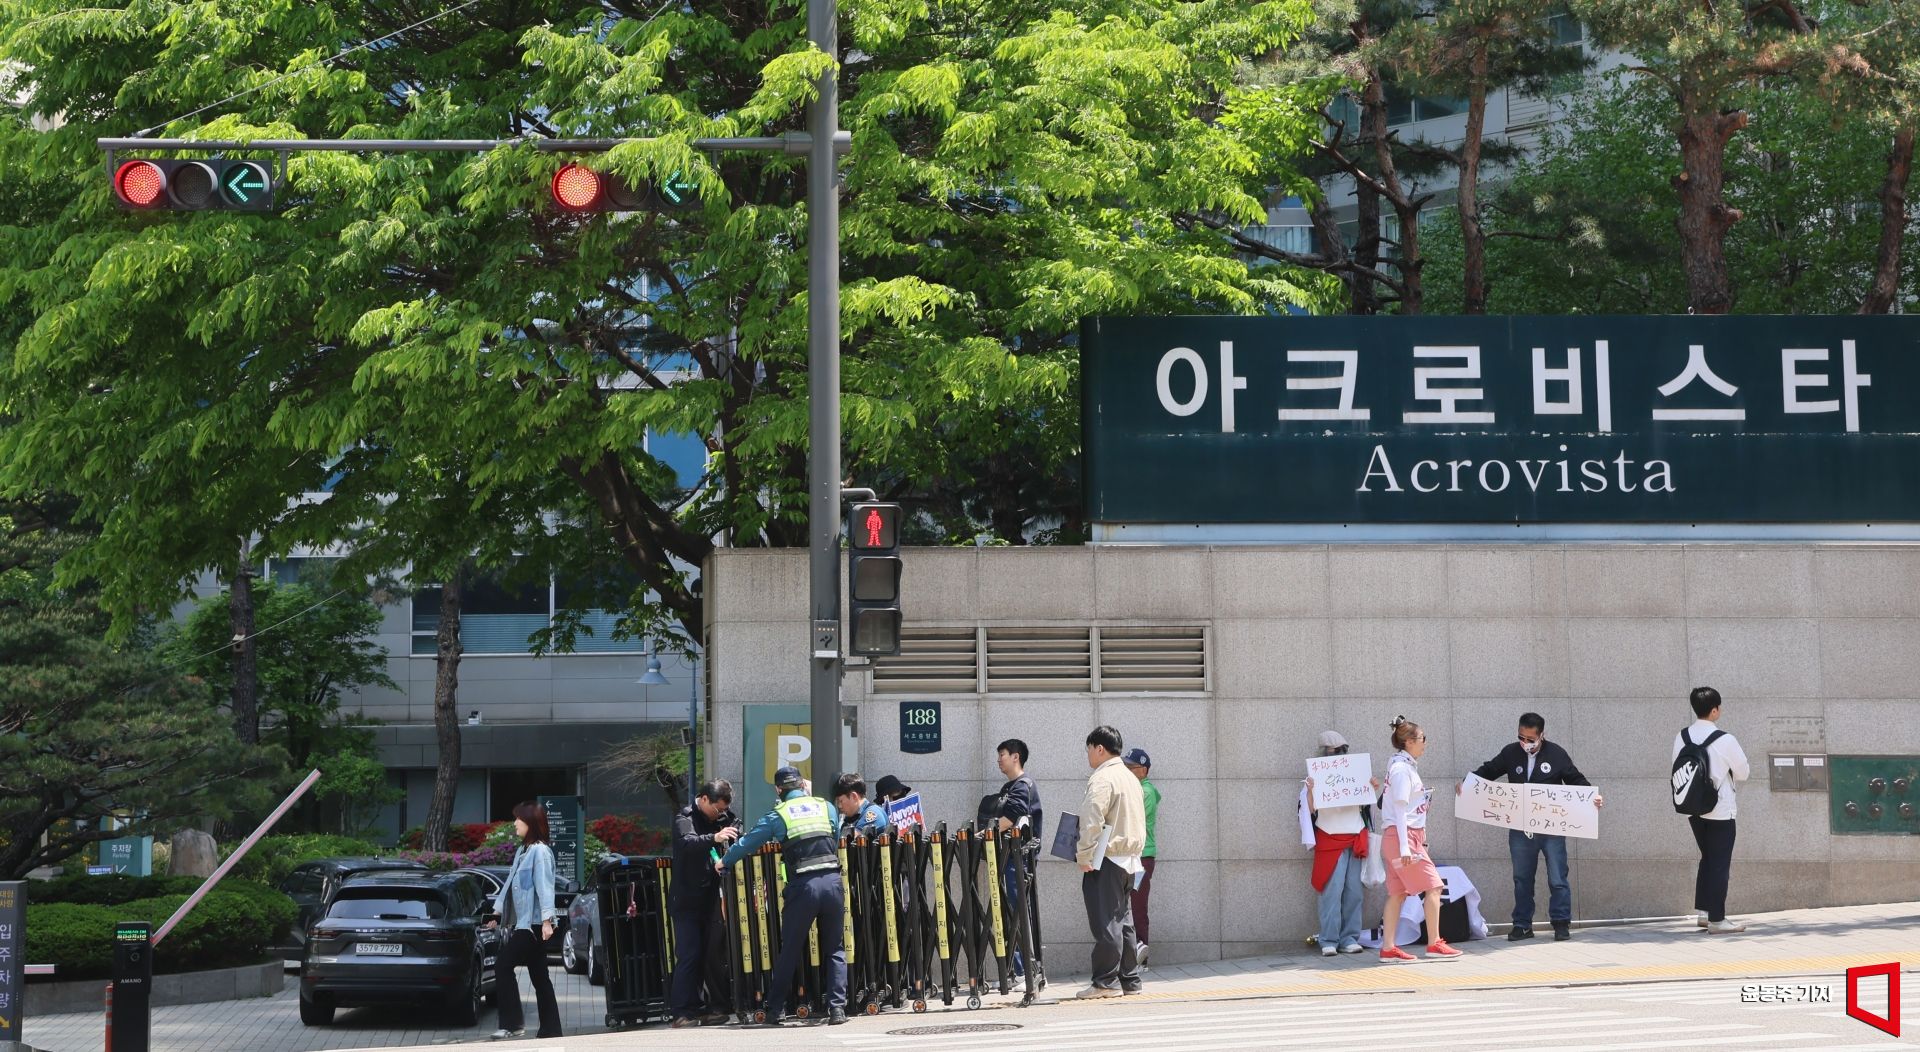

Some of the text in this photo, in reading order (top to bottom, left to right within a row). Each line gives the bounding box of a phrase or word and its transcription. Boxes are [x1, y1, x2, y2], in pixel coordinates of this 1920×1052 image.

[1156, 339, 1872, 433] 아크로비스타
[1357, 444, 1676, 494] Acrovista
[905, 708, 936, 725] 188
[778, 735, 811, 769] P
[1673, 761, 1693, 793] NIKE
[112, 844, 132, 852] 주차장
[757, 876, 765, 921] POLICE
[884, 867, 892, 912] POLICE
[989, 862, 998, 907] POLICE
